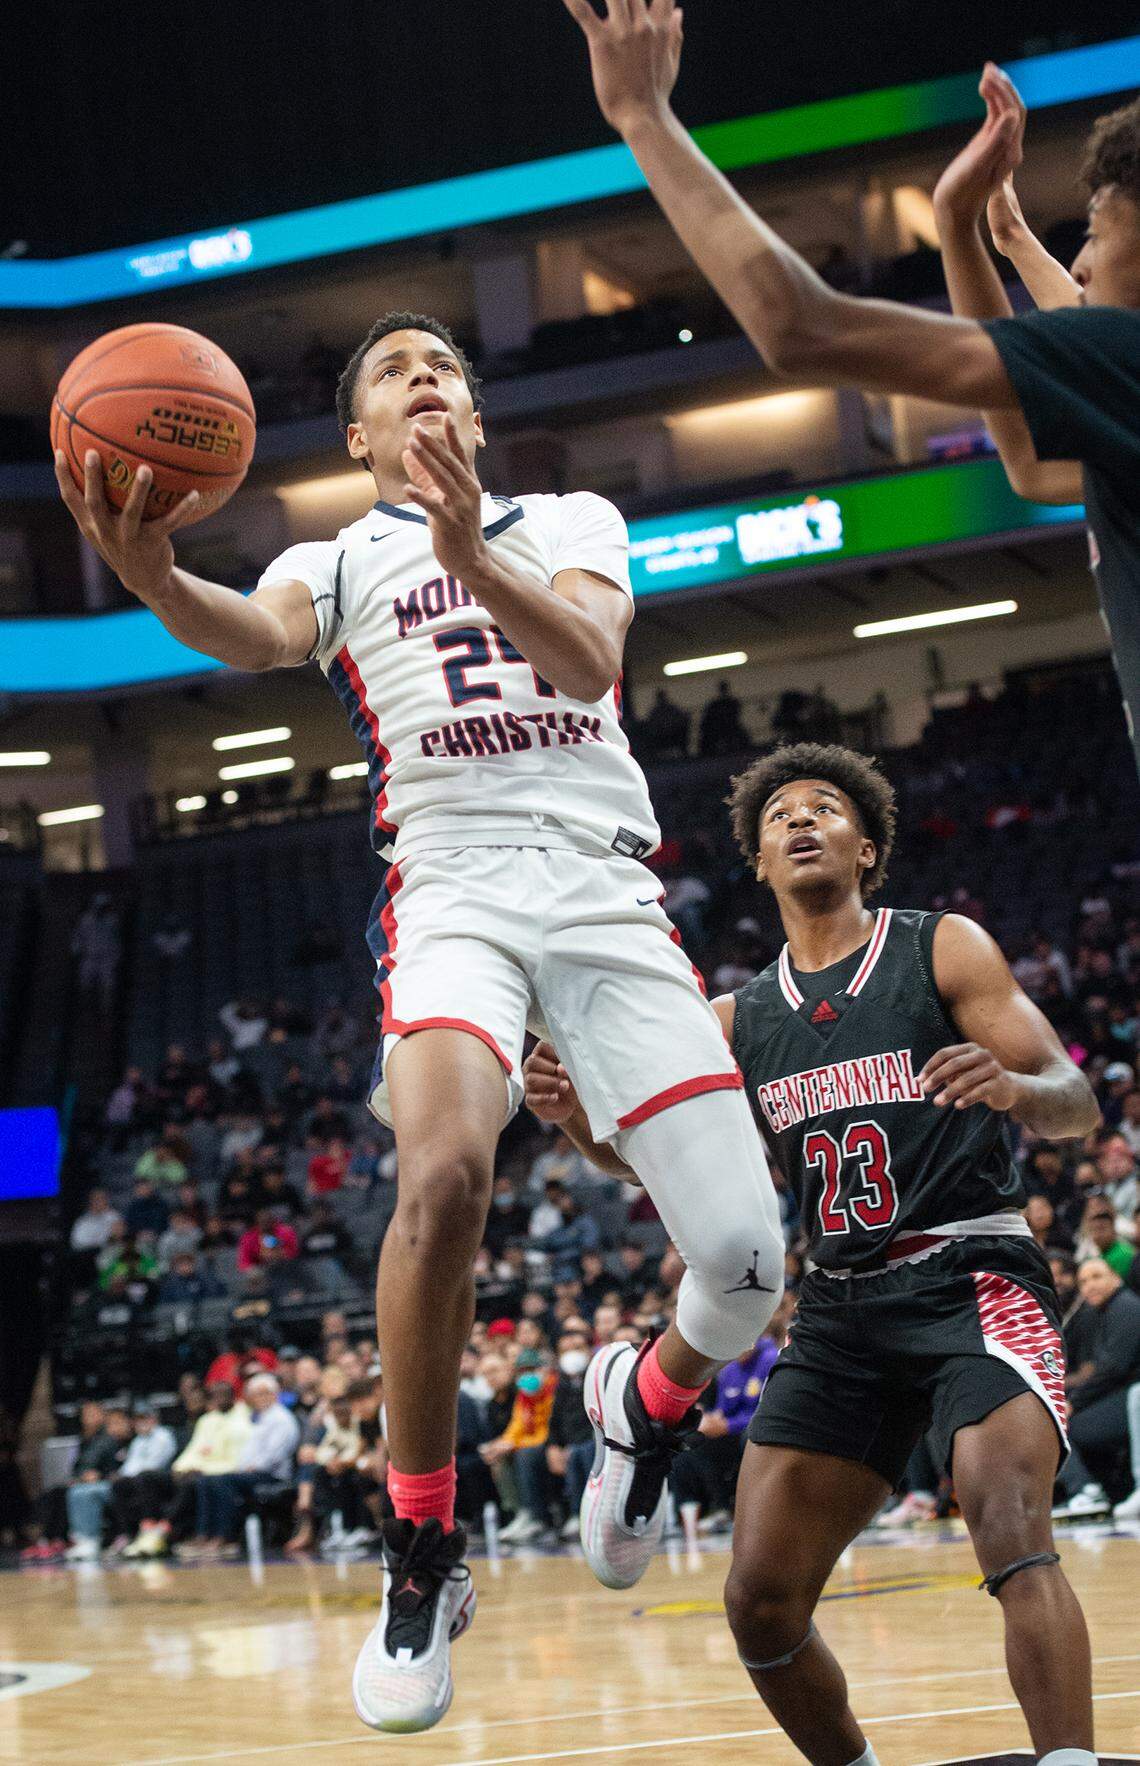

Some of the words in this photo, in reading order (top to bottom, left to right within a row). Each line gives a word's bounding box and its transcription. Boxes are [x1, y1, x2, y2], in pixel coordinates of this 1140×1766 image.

[136, 419, 243, 457] LEGACY
[757, 1049, 925, 1133] CENTENNIAL
[803, 1120, 899, 1236] 23
